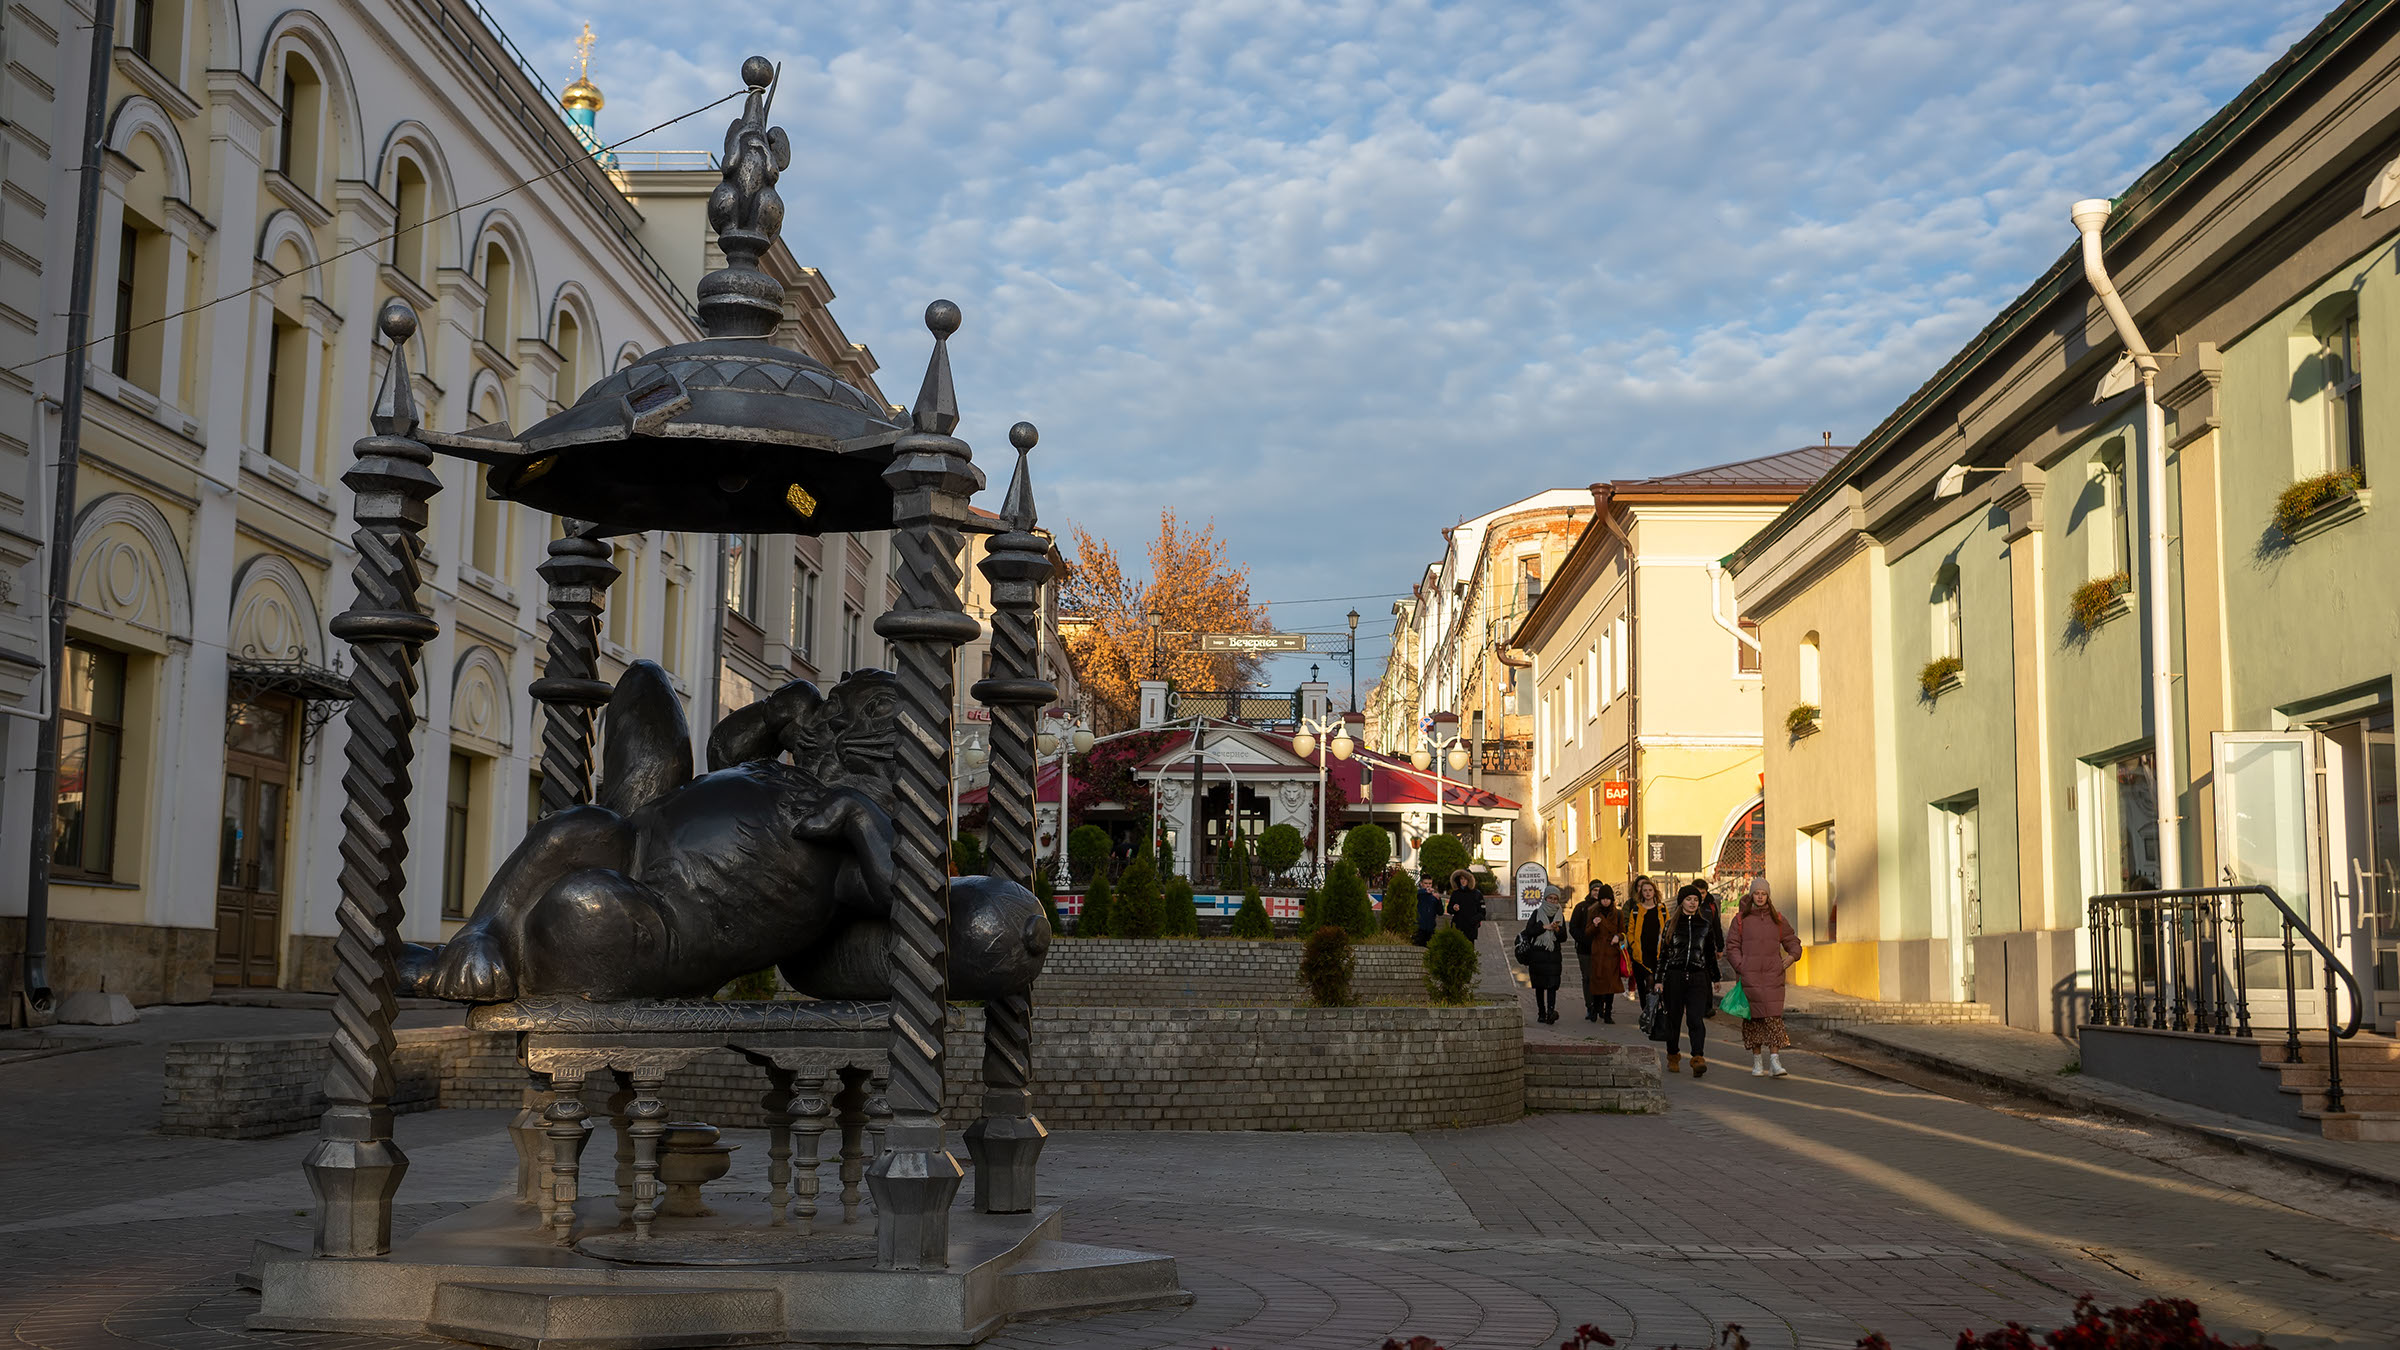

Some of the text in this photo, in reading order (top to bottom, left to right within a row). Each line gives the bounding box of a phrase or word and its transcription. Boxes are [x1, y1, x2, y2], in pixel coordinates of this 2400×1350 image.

[1228, 637, 1278, 648] Вечернее
[1606, 788, 1628, 799] БАР
[1523, 889, 1541, 899] 220
